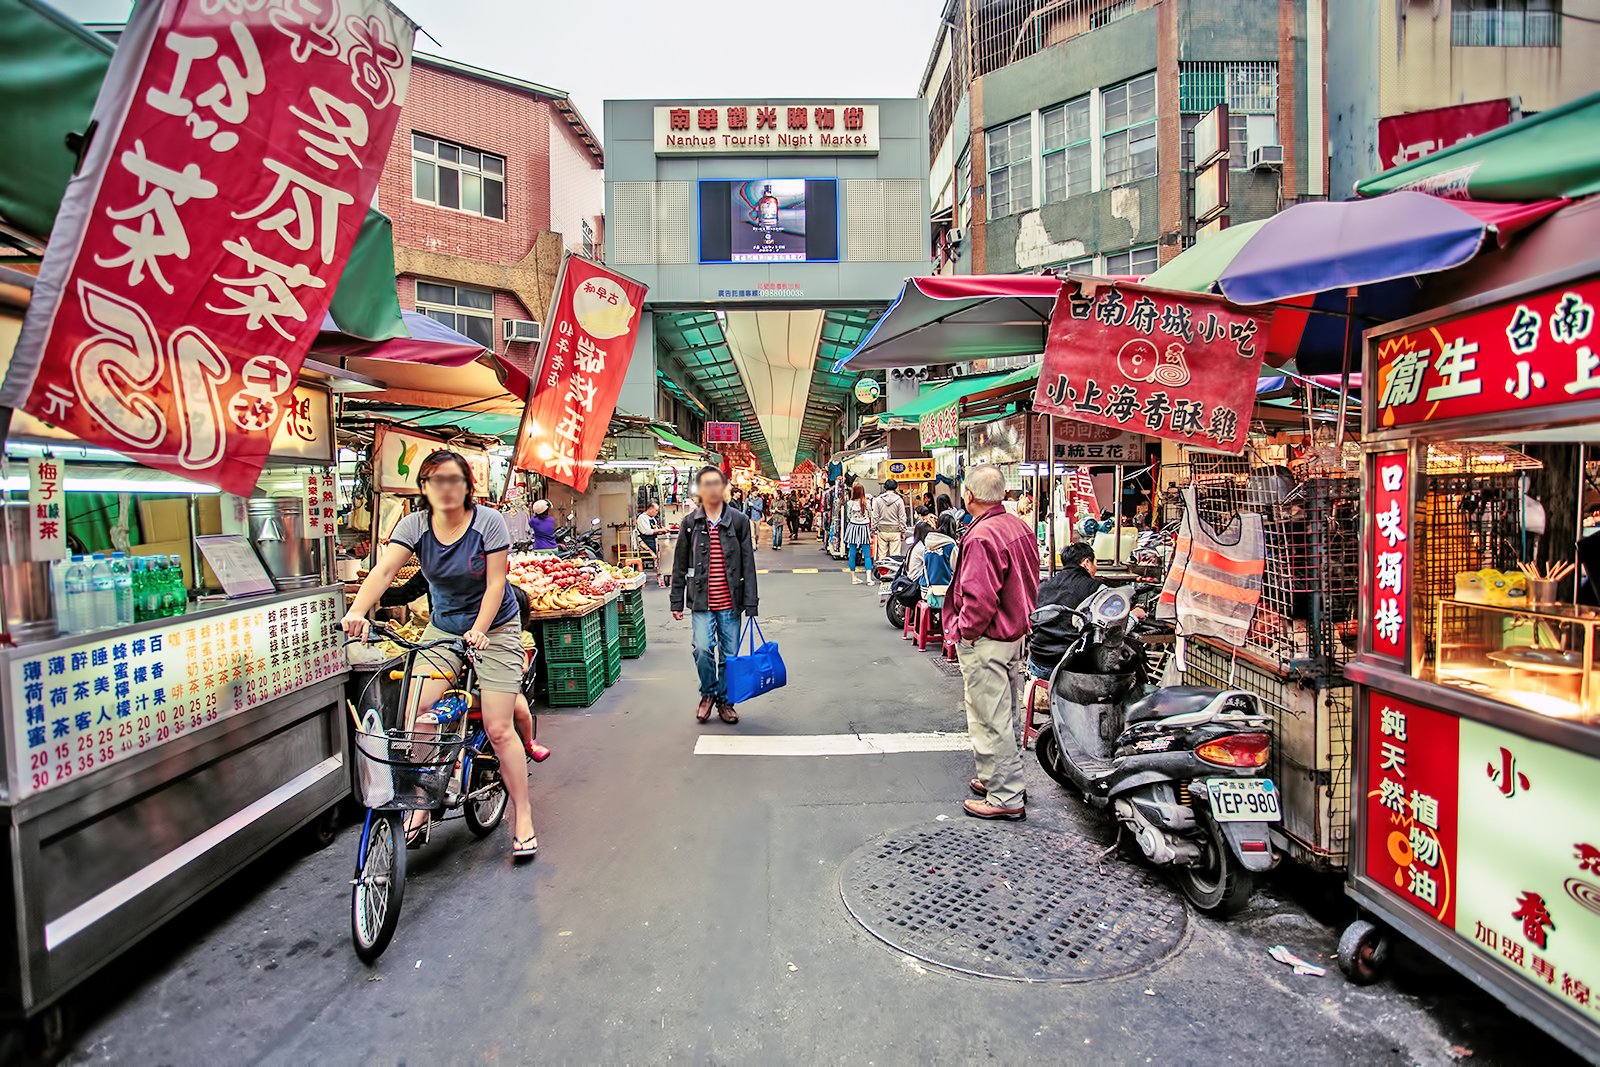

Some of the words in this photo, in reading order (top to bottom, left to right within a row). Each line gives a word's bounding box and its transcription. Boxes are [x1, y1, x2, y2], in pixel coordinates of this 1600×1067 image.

[666, 134, 716, 147] Nanhua
[722, 134, 770, 146] Tourist
[778, 133, 814, 147] Night
[820, 133, 868, 146] Market
[669, 107, 864, 130] 南華觀光購物街
[1068, 290, 1258, 359] 台南府城小吃
[1505, 292, 1593, 355] 台南
[1378, 336, 1481, 409] 衛生
[286, 394, 318, 442] 想
[1046, 374, 1240, 444] 小上海香酥雞
[37, 462, 60, 540] 梅子紅綠茶
[322, 475, 335, 535] 冷熱飲料
[1374, 464, 1407, 645] 口味獨特
[71, 652, 92, 731] 醉茶客
[92, 647, 112, 724] 睡美人
[112, 643, 131, 720] 蜂蜜檸檬
[132, 639, 149, 712] 檸檬汁
[150, 634, 166, 706] 百香果
[48, 656, 70, 739] 薄荷茶
[156, 710, 166, 724] 10
[78, 734, 93, 751] 25
[99, 728, 113, 744] 25
[119, 722, 132, 737] 25
[121, 740, 132, 751] 40
[138, 716, 150, 731] 20
[138, 734, 150, 748] 35
[157, 726, 169, 741] 20
[31, 751, 48, 770] 20
[56, 743, 70, 759] 15
[56, 762, 72, 780] 25
[78, 753, 94, 771] 35
[100, 746, 114, 762] 35
[1380, 706, 1408, 815] 純天然
[1486, 746, 1531, 798] 小
[32, 771, 48, 790] 30
[1212, 792, 1277, 814] YEP-980
[1407, 789, 1440, 908] 植物油
[1511, 891, 1556, 950] 香
